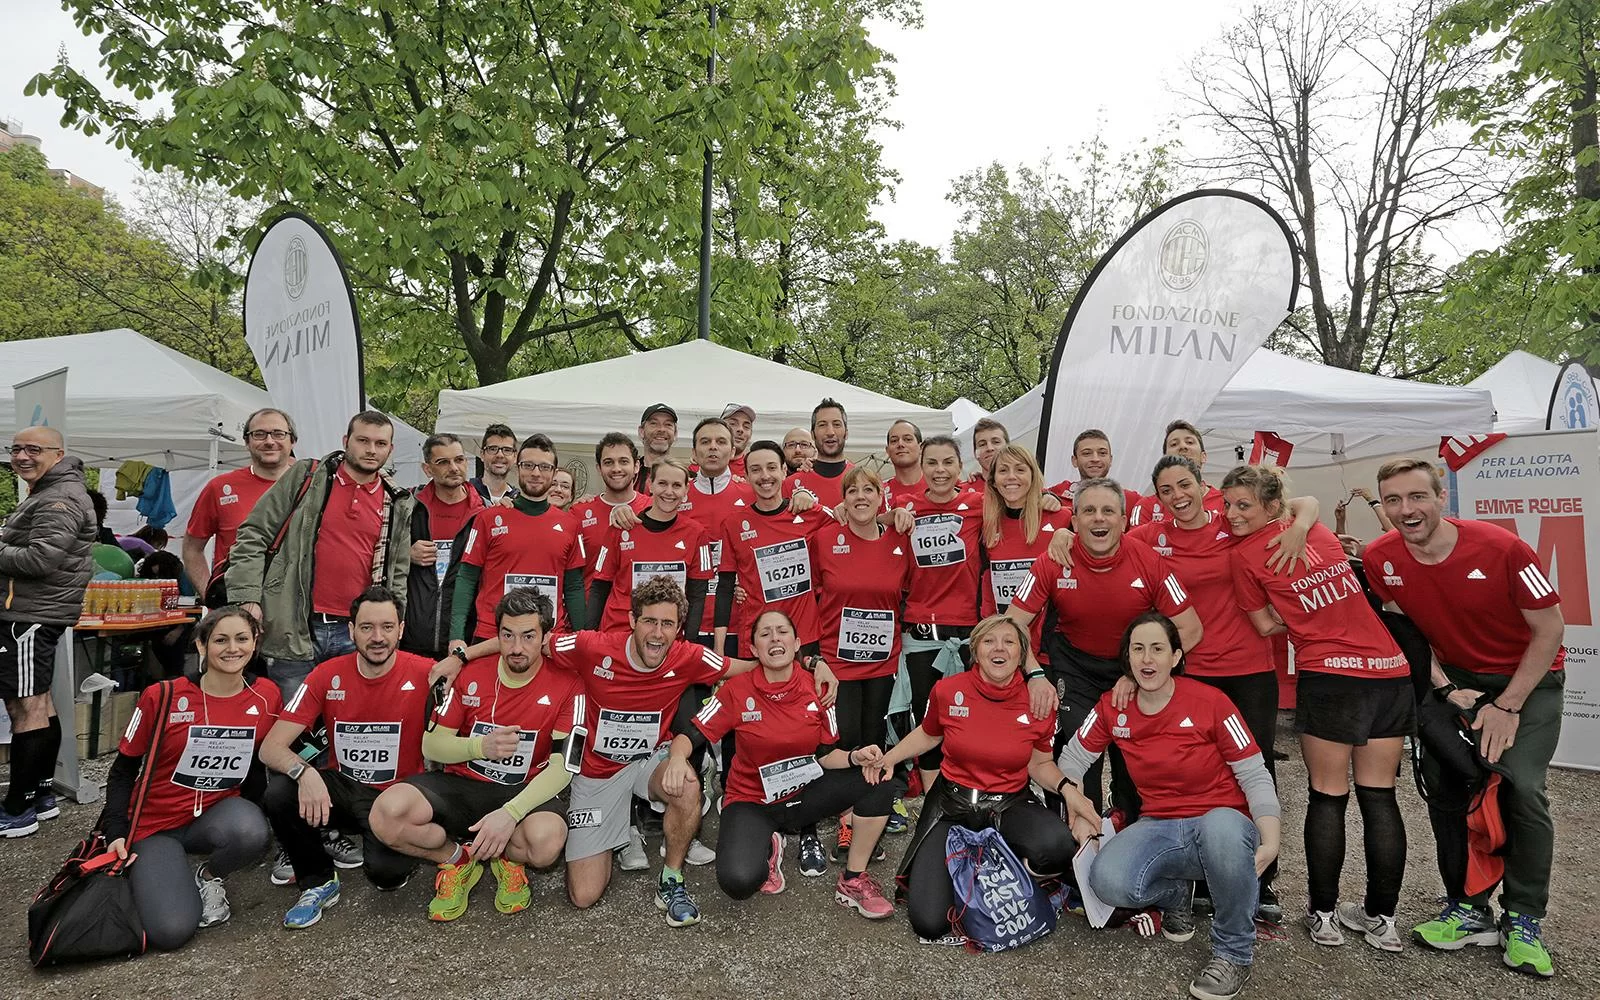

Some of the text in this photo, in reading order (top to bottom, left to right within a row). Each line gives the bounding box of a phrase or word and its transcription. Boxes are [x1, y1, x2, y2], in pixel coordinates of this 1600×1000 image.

[1172, 225, 1200, 237] ACM
[1168, 275, 1192, 284] 1899
[1112, 304, 1241, 328] FONDAZIONE
[1109, 325, 1237, 362] MILAN
[1482, 454, 1573, 467] PER LA LOTTA
[1476, 466, 1580, 479] AL MELANOMA
[1476, 498, 1583, 514] EMME ROUGE
[917, 533, 957, 549] 1616A
[930, 552, 949, 563] EA7
[765, 563, 806, 582] 1627B
[1290, 560, 1351, 592] FONDAZION
[780, 583, 799, 595] EA7
[996, 586, 1017, 598] 163
[846, 631, 888, 646] 1628C
[854, 650, 874, 658] EA7
[1324, 656, 1364, 668] COSCE
[603, 736, 648, 750] 1637A
[342, 748, 389, 762] 1621B
[190, 755, 242, 770] 1621C
[352, 770, 376, 779] EA7
[485, 767, 508, 780] EA7
[194, 777, 222, 787] EA7
[568, 812, 594, 826] 637A
[983, 880, 1024, 909] FAST
[990, 899, 1029, 924] LIVE
[995, 912, 1036, 938] COOL
